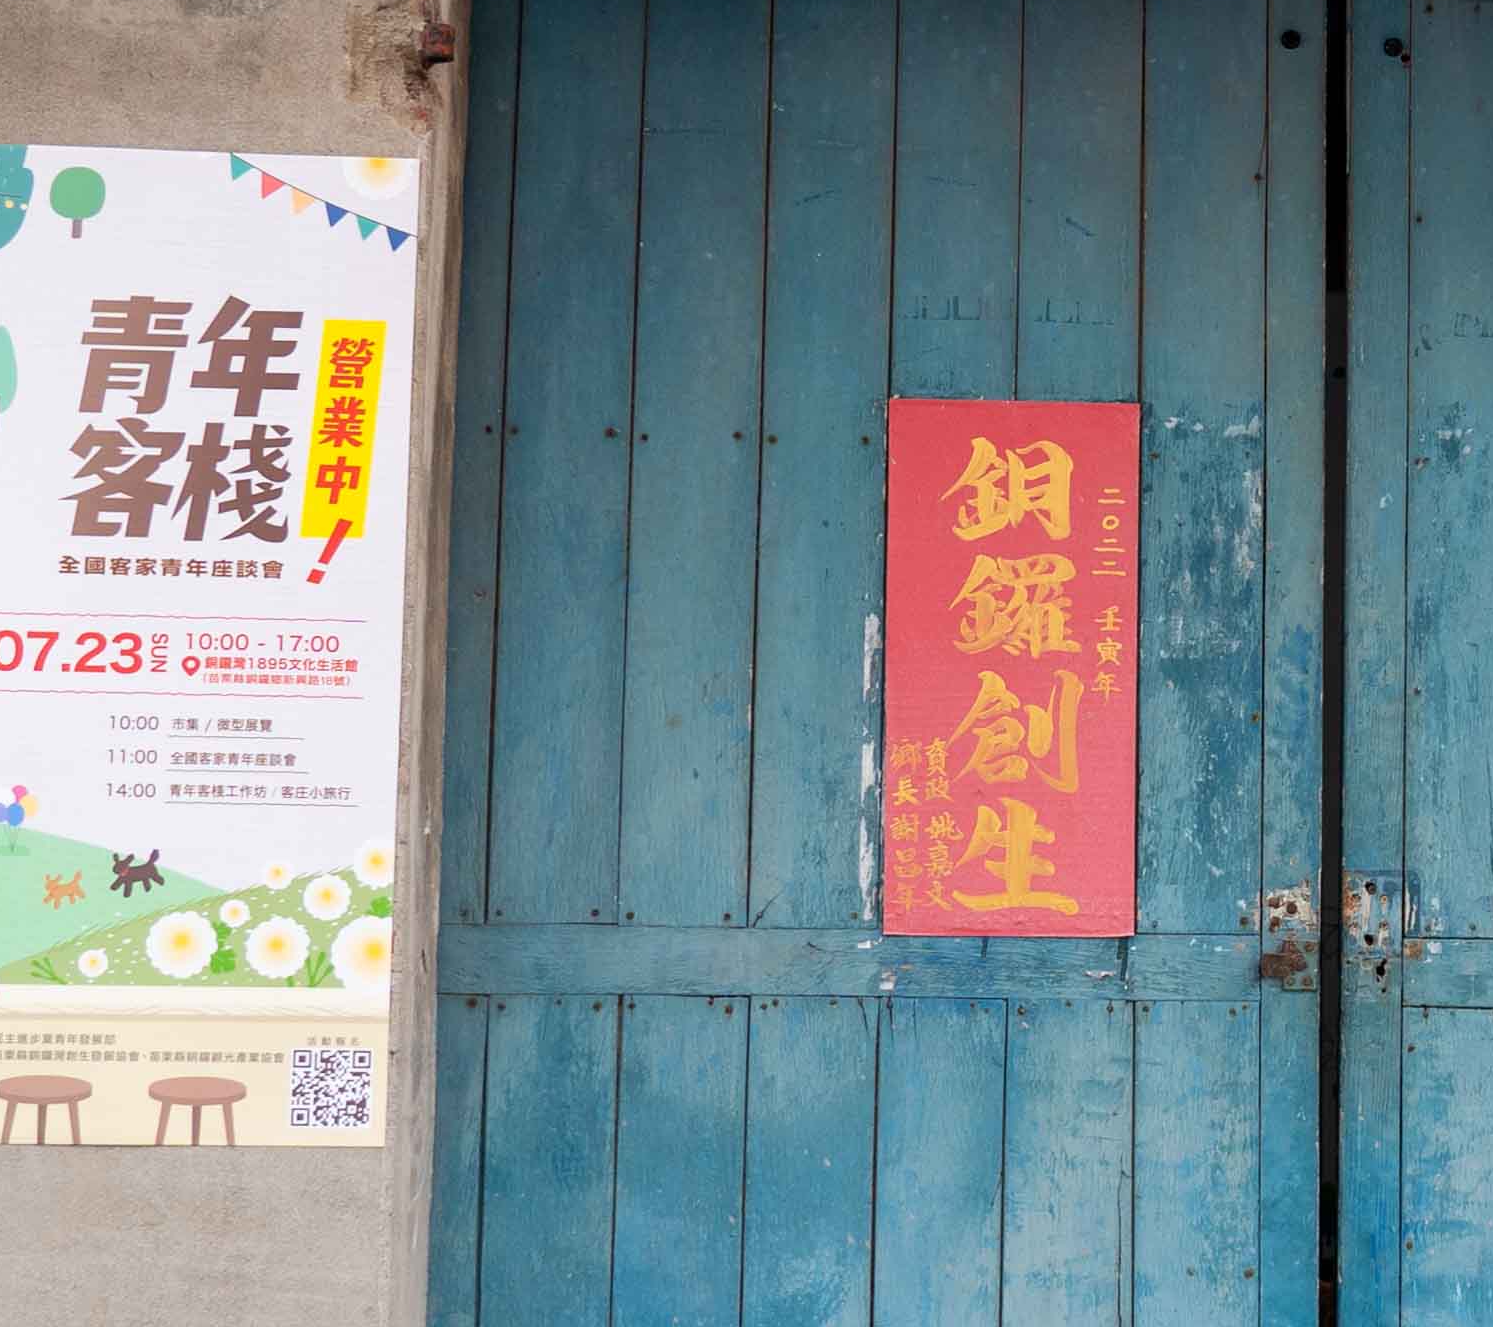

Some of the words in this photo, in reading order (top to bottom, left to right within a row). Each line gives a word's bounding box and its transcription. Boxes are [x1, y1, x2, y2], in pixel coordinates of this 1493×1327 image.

[78, 295, 304, 417] 青年
[57, 417, 293, 543] 客棧
[58, 555, 284, 579] 全國客家青年座談會
[150, 633, 169, 672] SUN
[185, 633, 249, 651] 10:00
[276, 635, 340, 653] 17:00
[940, 437, 1084, 915] 銅鑼創生
[109, 715, 159, 731] 10:00
[171, 717, 199, 732] 市集
[107, 749, 158, 764] 11:00
[170, 751, 296, 767] 全國客家青年座談會
[106, 783, 156, 798] 14:00
